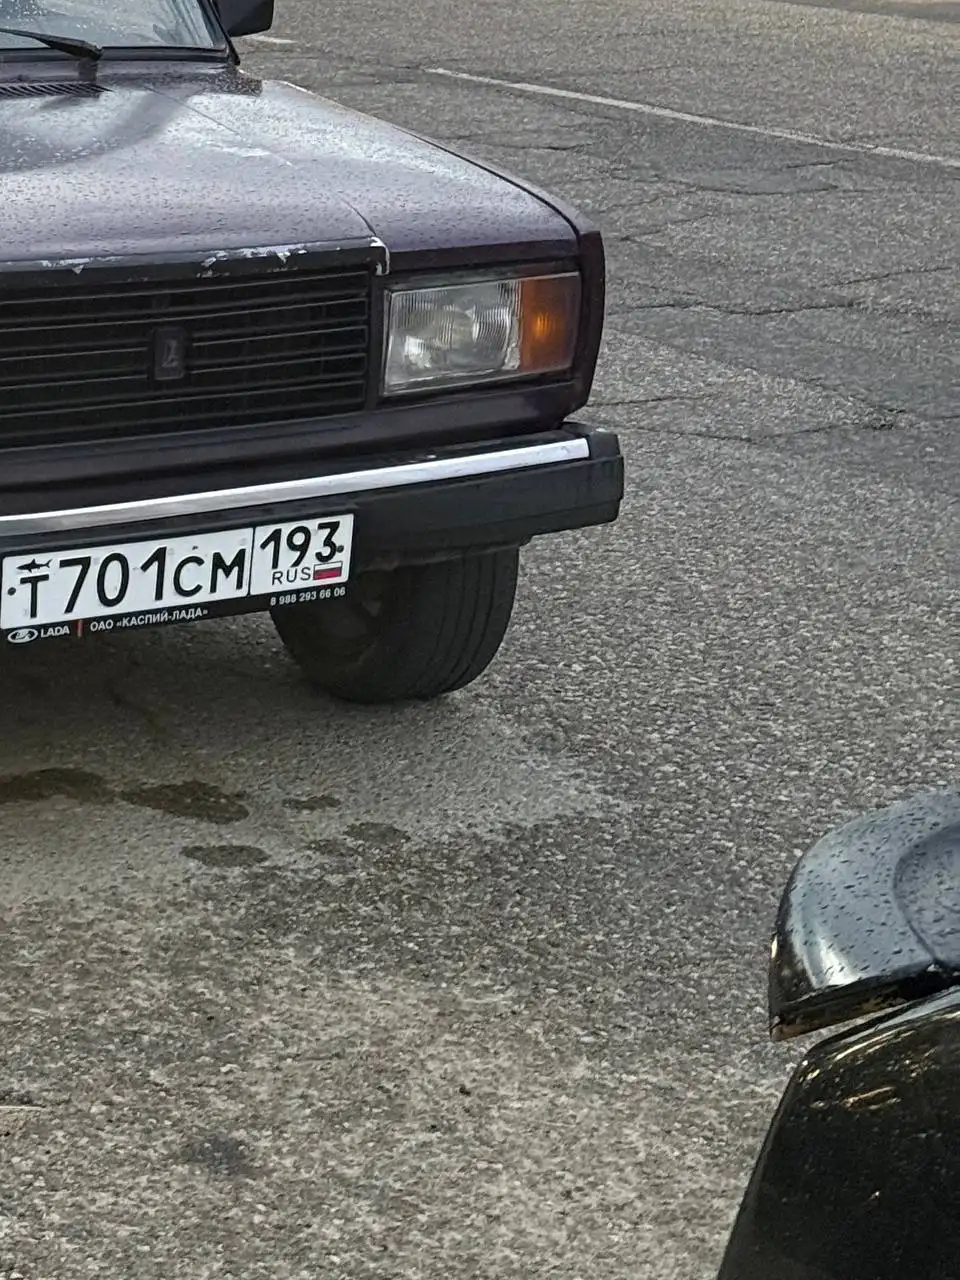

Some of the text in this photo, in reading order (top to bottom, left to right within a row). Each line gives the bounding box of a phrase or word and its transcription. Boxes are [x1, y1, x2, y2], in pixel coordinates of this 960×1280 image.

[260, 520, 341, 570] 193
[271, 566, 312, 586] RUS
[299, 590, 317, 602] 293
[40, 625, 70, 638] LADA
[90, 621, 114, 632] ОАО
